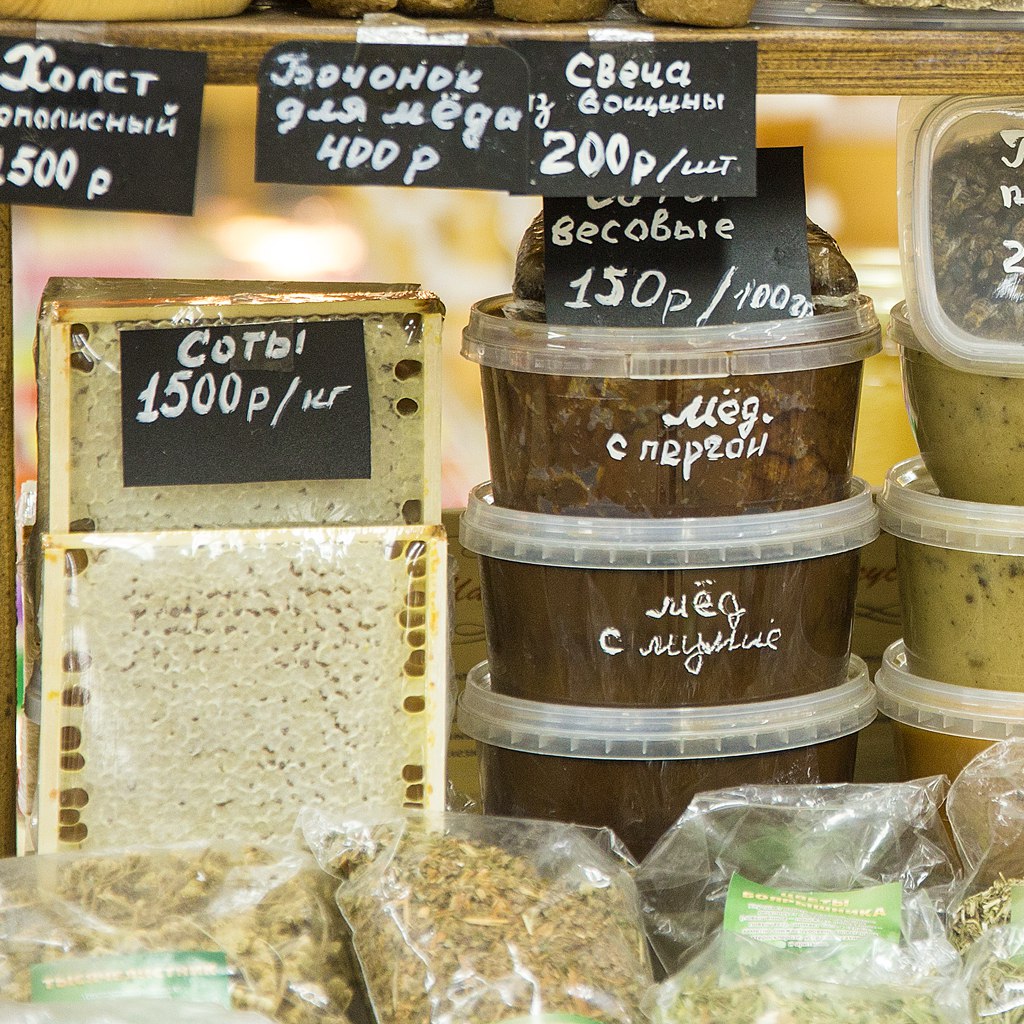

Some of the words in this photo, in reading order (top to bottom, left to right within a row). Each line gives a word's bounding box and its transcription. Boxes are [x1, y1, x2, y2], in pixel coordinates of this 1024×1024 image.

[0, 43, 160, 96] Холст
[270, 52, 483, 93] Бочонок
[565, 51, 692, 89] Свеча
[275, 96, 367, 135] для
[381, 92, 523, 150] мёда
[577, 88, 725, 117] вощины
[316, 134, 401, 171] 400
[403, 145, 440, 185] р
[540, 130, 738, 186] 200р/шт
[86, 166, 113, 200] р
[551, 208, 735, 246] весовые
[177, 329, 307, 369] Соты
[135, 370, 352, 429] 1500р/кг
[606, 432, 628, 461] с
[599, 626, 624, 656] с
